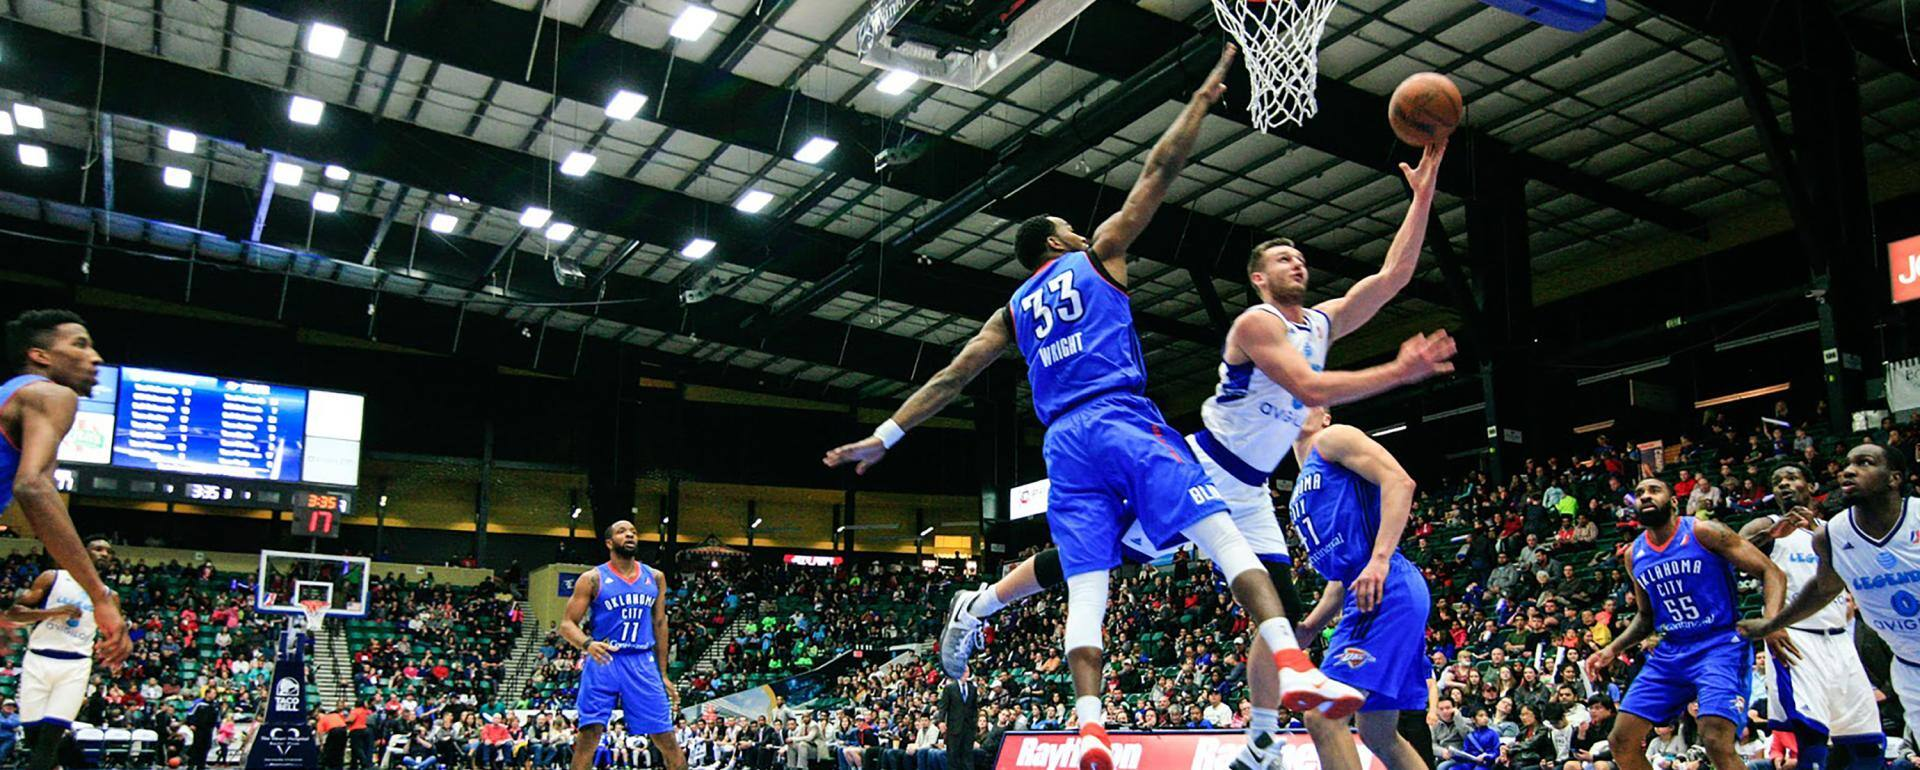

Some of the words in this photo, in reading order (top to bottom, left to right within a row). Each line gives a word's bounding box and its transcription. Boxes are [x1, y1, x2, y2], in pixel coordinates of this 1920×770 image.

[1021, 269, 1083, 339] 33
[1039, 331, 1083, 368] WRIGHT
[308, 493, 337, 509] 3:35
[308, 510, 333, 532] 17
[1656, 579, 1684, 597] CITY
[604, 593, 656, 611] OKLAHOM
[1663, 595, 1700, 622] 55
[621, 608, 643, 620] CITY
[621, 622, 639, 643] 11
[276, 704, 299, 712] BELL
